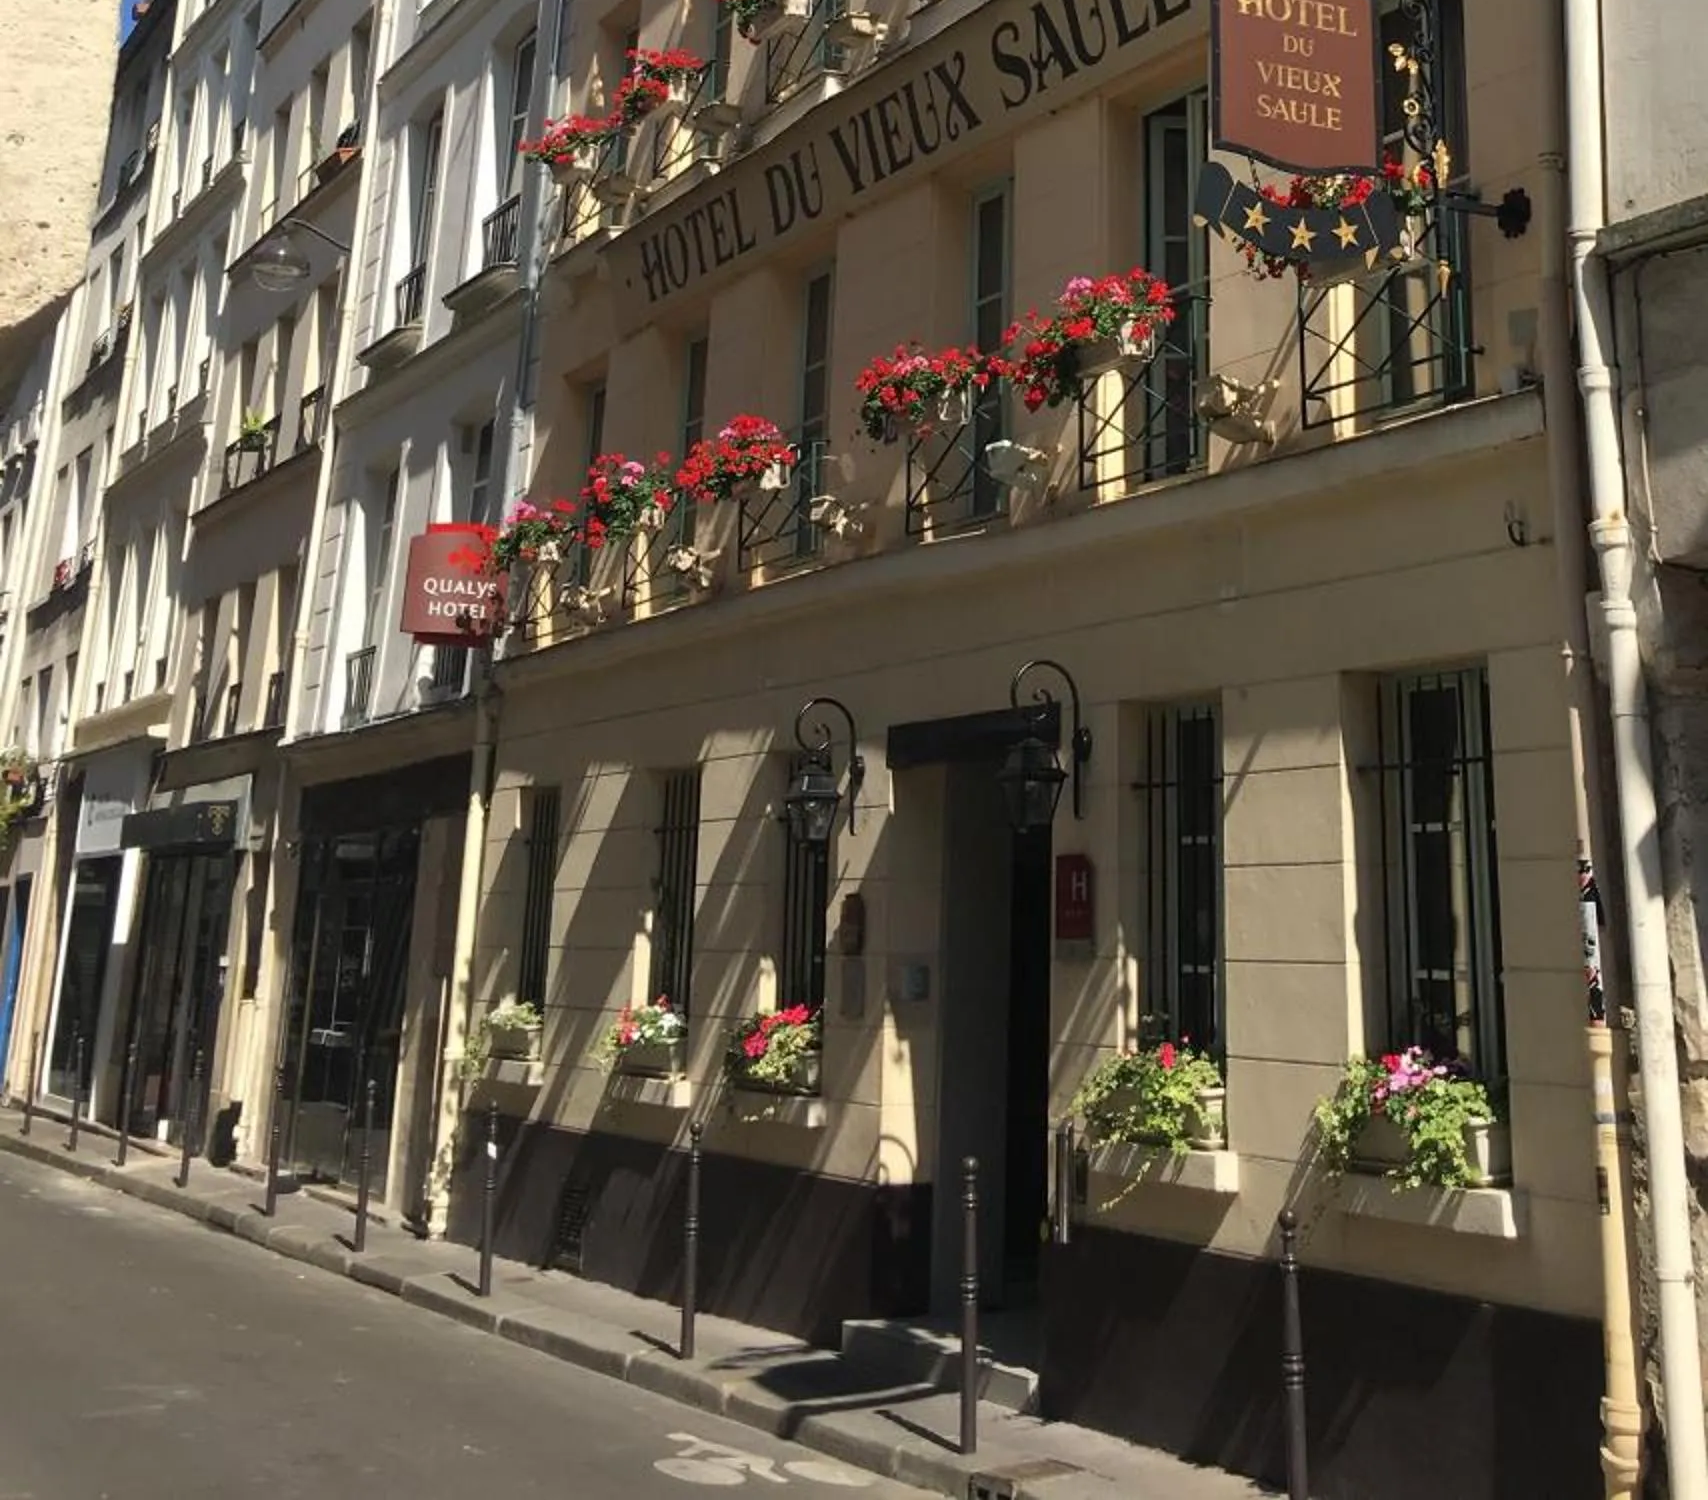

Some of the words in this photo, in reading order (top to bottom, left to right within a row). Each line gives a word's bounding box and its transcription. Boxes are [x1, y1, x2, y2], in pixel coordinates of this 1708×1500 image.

[1283, 35, 1314, 56] DU
[1255, 61, 1343, 99] VIEUX
[1256, 94, 1343, 131] SAULE
[640, 188, 756, 302] HOTEL
[765, 142, 824, 236] DU
[828, 51, 981, 195] VIEUX
[1071, 871, 1088, 902] H
